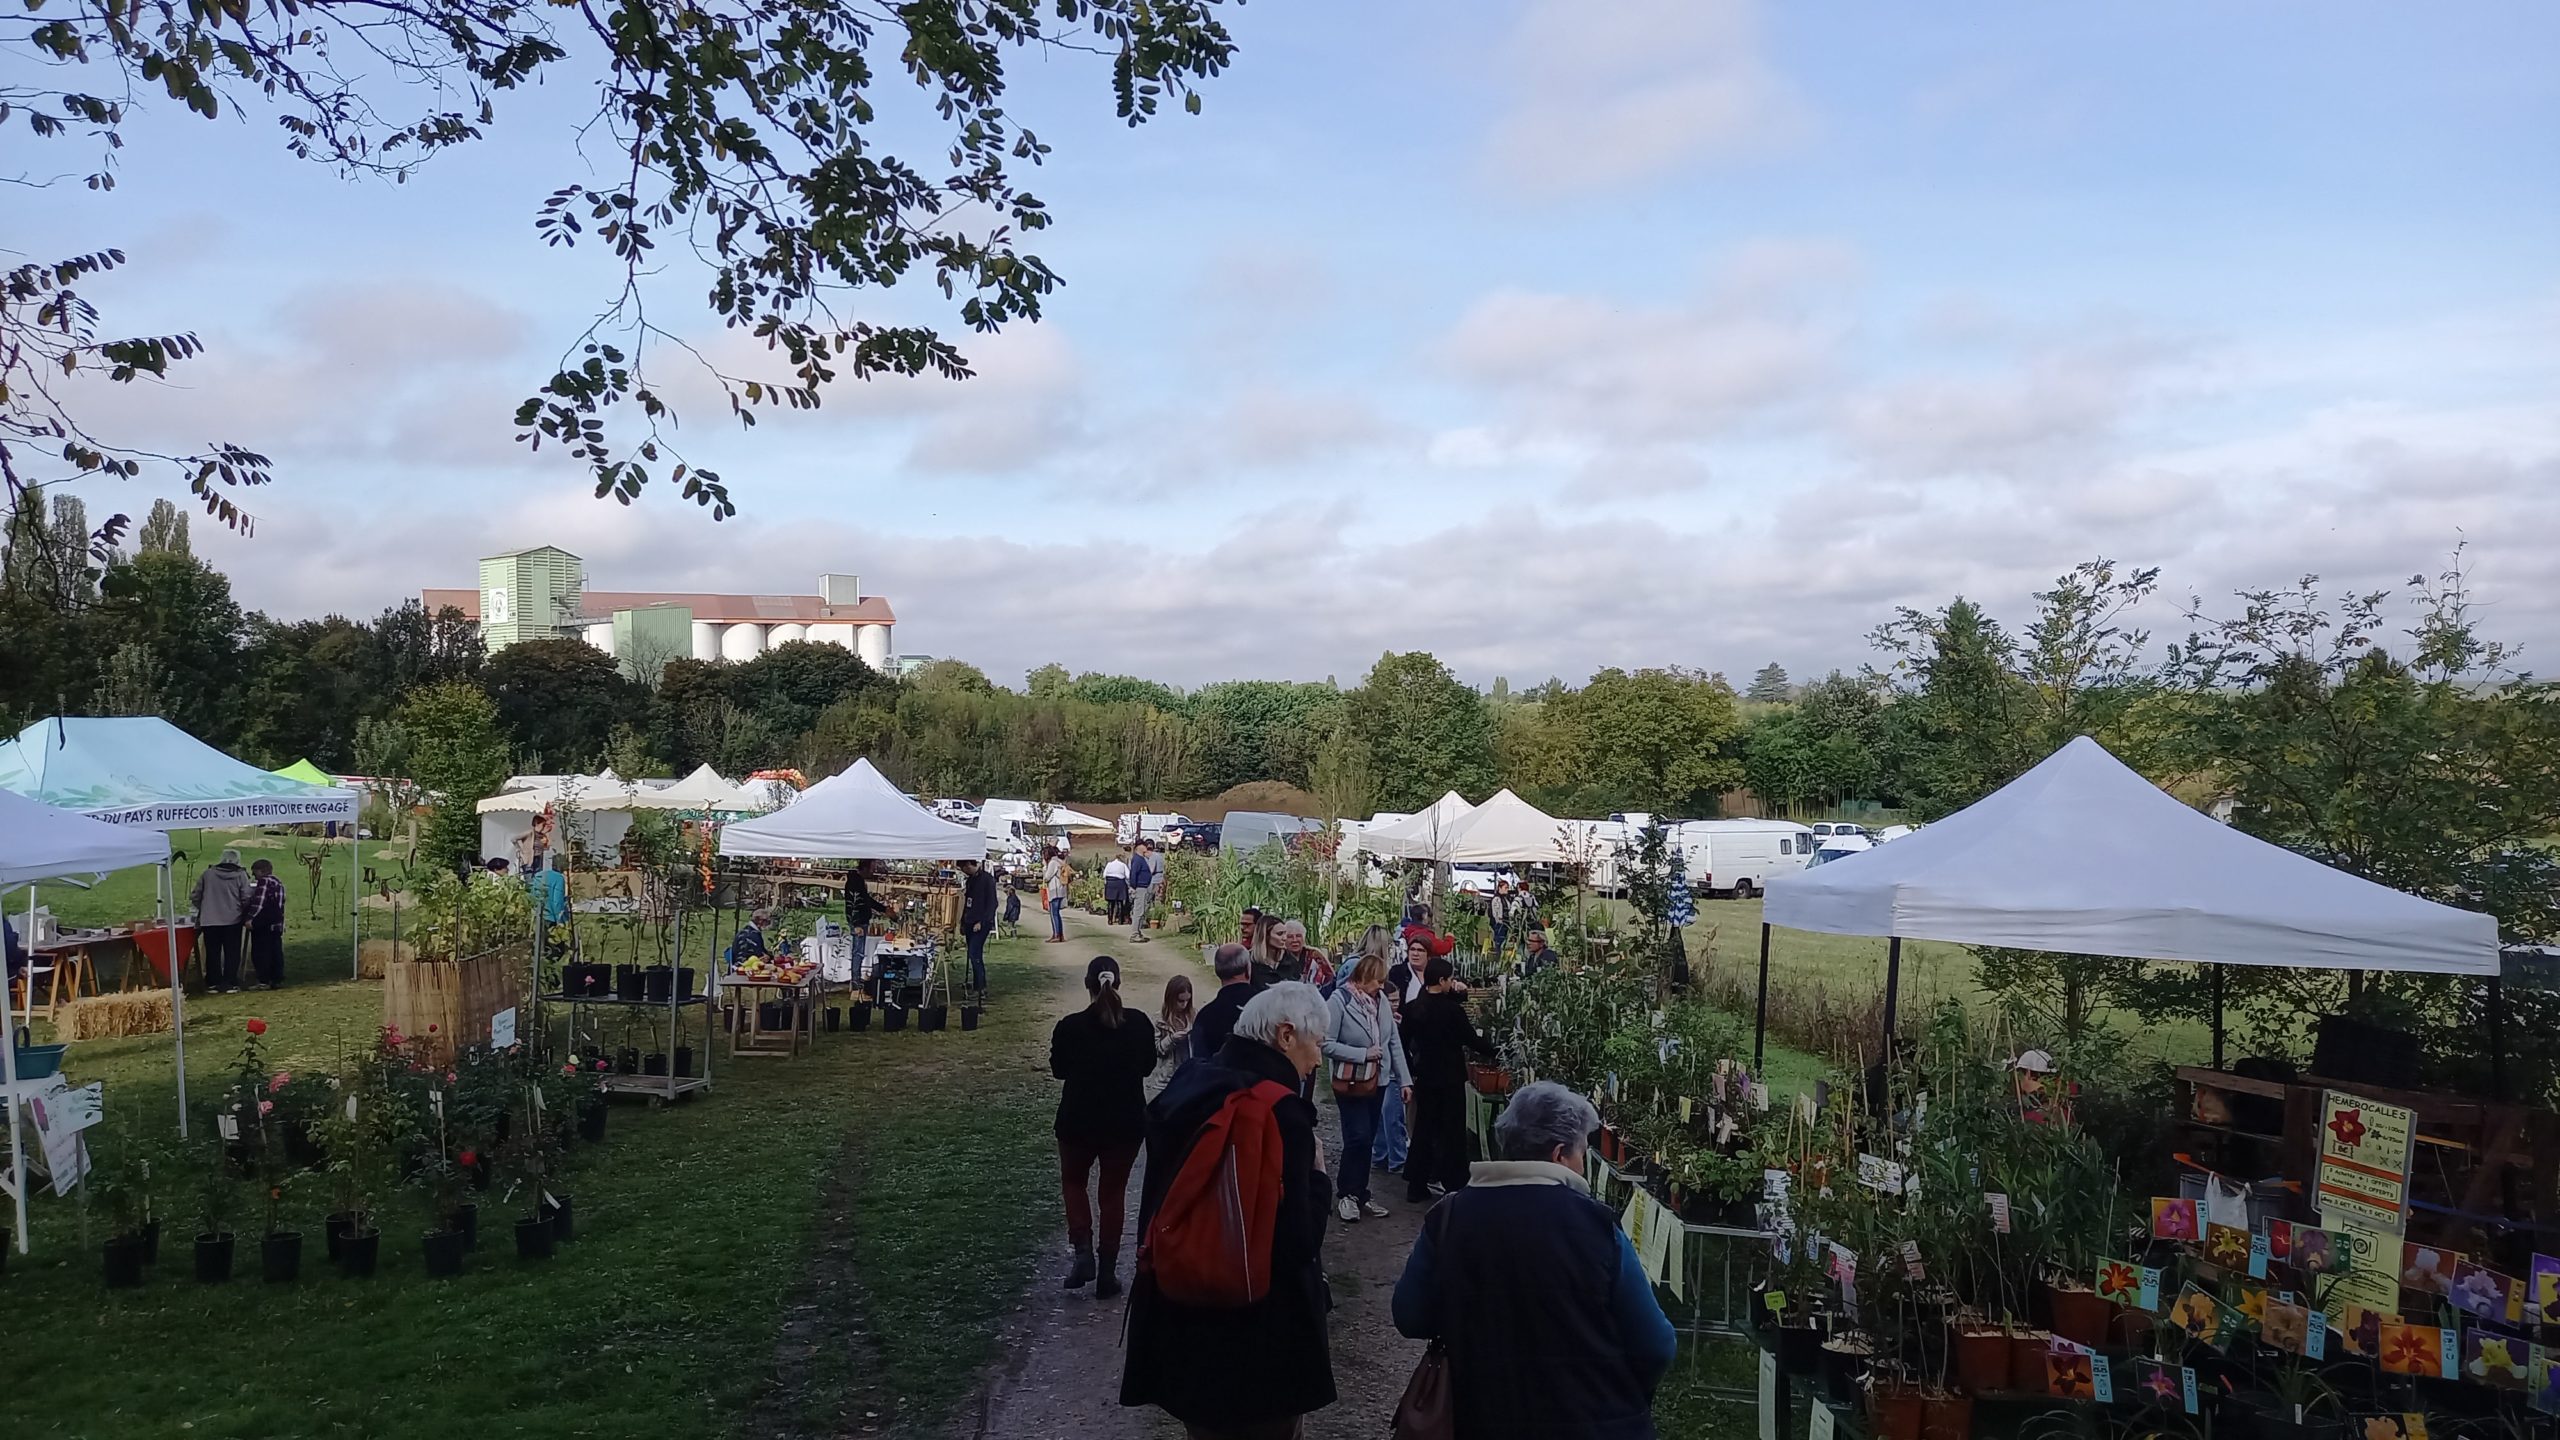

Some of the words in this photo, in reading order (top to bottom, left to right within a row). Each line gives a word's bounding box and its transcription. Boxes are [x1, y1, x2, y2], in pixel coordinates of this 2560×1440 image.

[103, 812, 122, 824] DU
[124, 809, 153, 824] PAYS
[156, 805, 219, 821] RUFFÉCOIS
[228, 807, 245, 818] UN
[247, 803, 303, 817] TERRITOIRE
[305, 799, 349, 814] ENGAGÉ
[2328, 1094, 2407, 1120] HEMEROCALLES
